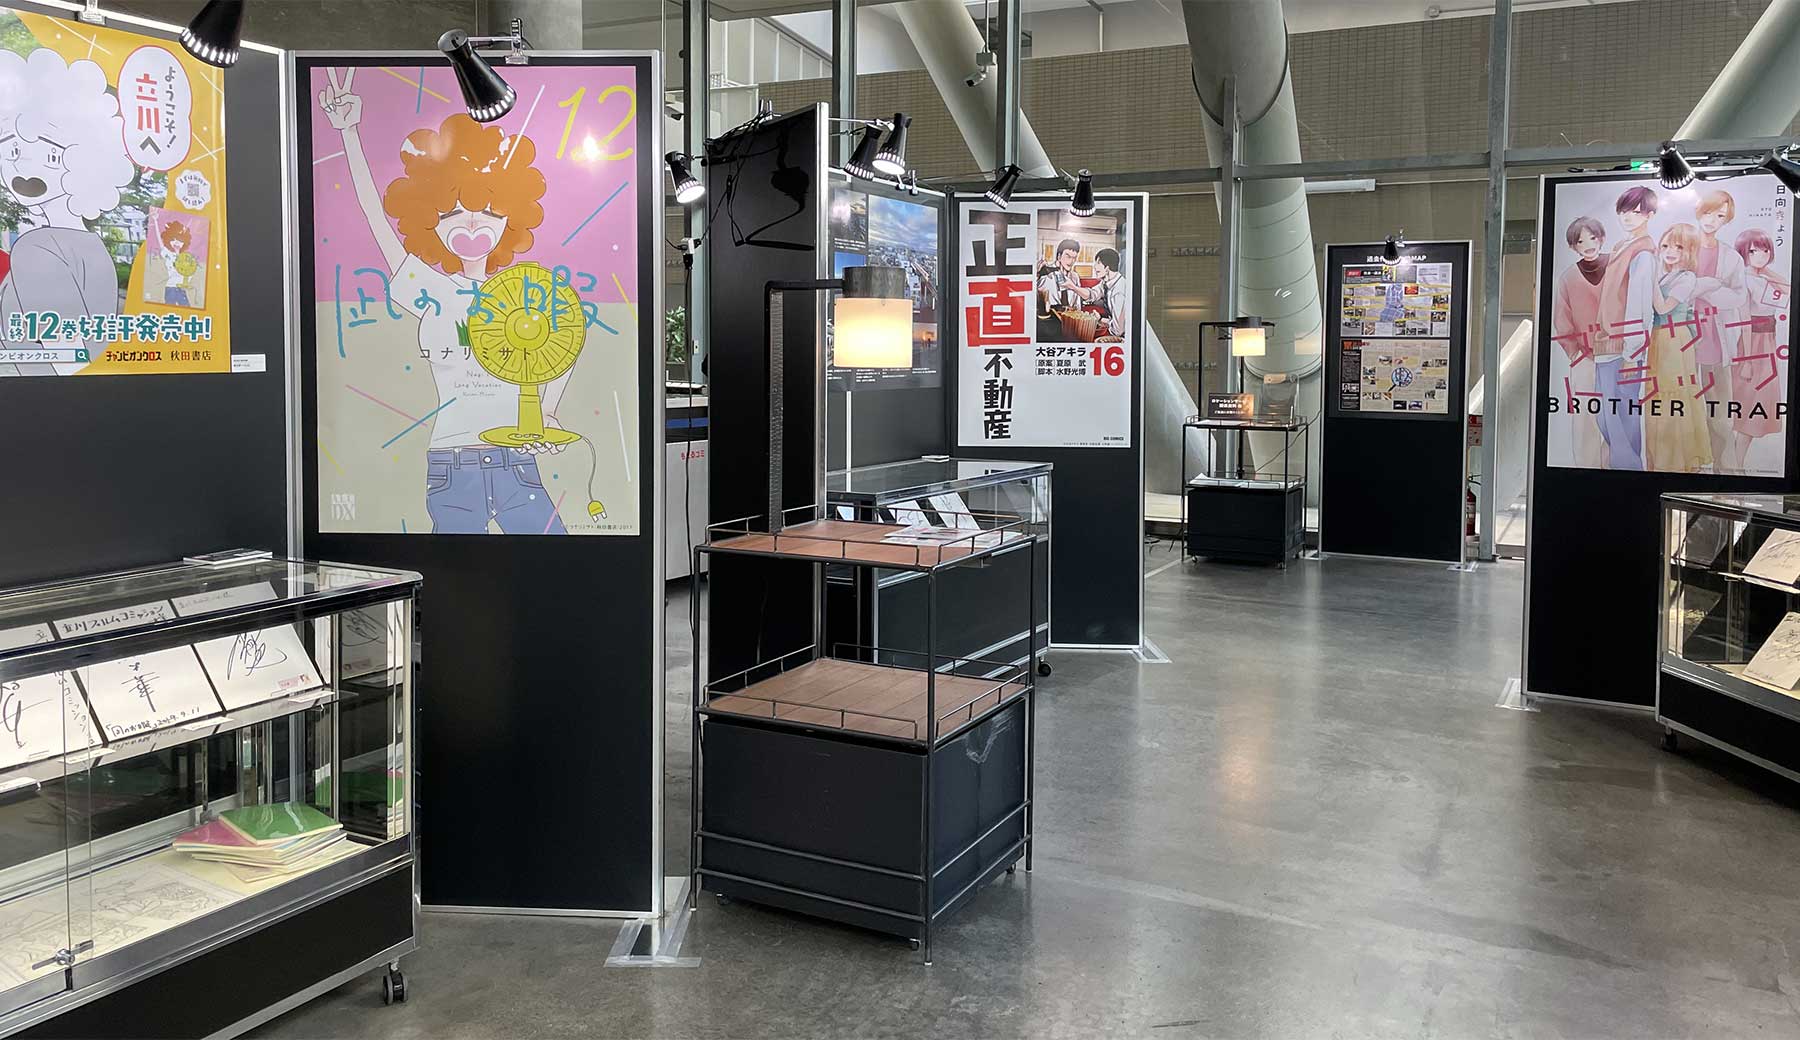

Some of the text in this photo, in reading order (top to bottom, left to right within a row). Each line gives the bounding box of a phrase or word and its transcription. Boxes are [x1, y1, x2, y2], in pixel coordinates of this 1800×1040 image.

[135, 72, 162, 155] 立川へ
[164, 66, 177, 149] ようこそ!
[558, 84, 637, 162] 12
[1772, 289, 1782, 301] 9
[335, 264, 619, 359] 凪のお暇
[965, 208, 1034, 440] 正直不動産
[106, 350, 211, 361] チャンピオンクロス 秋田書店
[419, 346, 532, 361] コナリミサト
[1035, 346, 1087, 357] 大谷アキラ
[1089, 345, 1125, 377] 16
[1548, 396, 1789, 420] BROTHER TRAP
